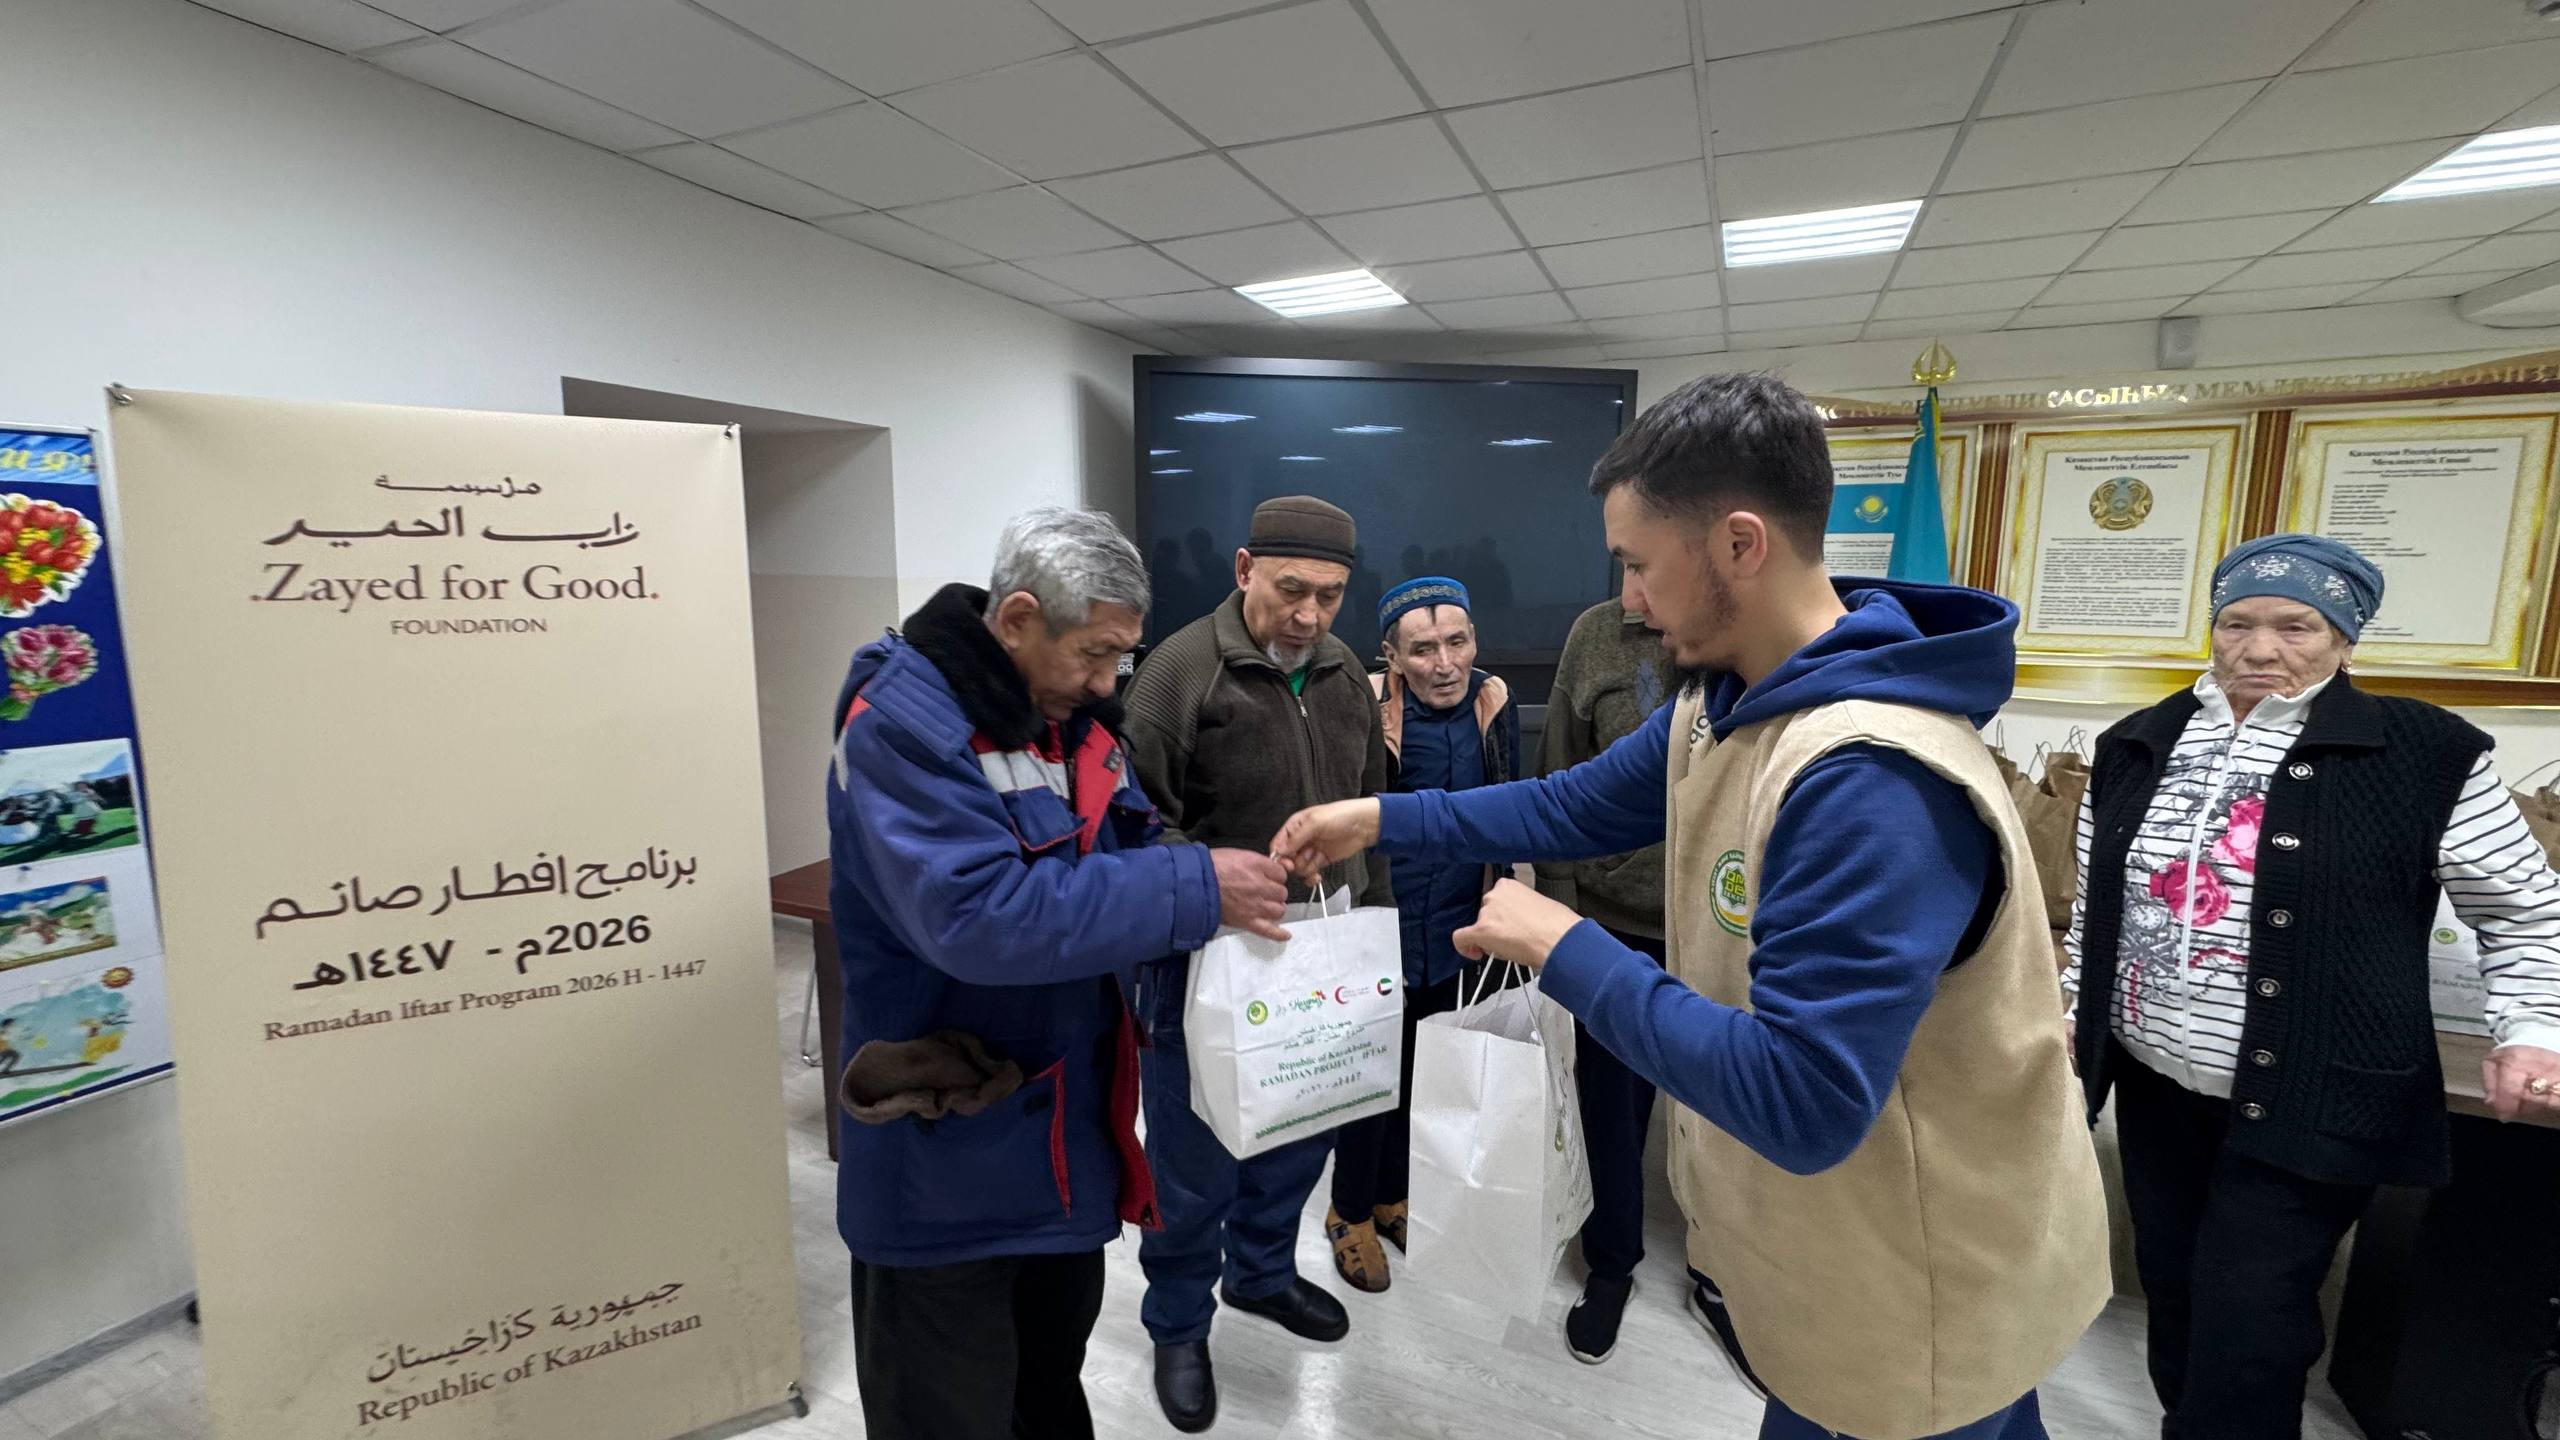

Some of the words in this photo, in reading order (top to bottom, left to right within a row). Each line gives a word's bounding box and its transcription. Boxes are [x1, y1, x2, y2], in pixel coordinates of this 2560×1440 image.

[441, 564, 508, 601] for
[391, 618, 547, 636] FOUNDATION
[574, 846, 697, 899] برنامج
[263, 1008, 393, 1041] Ramadan
[400, 995, 452, 1020] Iftar
[459, 983, 562, 1010] Program
[566, 971, 618, 995] 2026
[622, 967, 643, 987] H
[662, 959, 706, 981] 1447
[1260, 1069, 1313, 1088] RAMADAN
[1313, 1056, 1354, 1076] PROJECT
[1278, 1057, 1316, 1072] Republic
[358, 1373, 496, 1426] Republic
[503, 1354, 537, 1384] of
[543, 1313, 702, 1372] Kazakhstan
